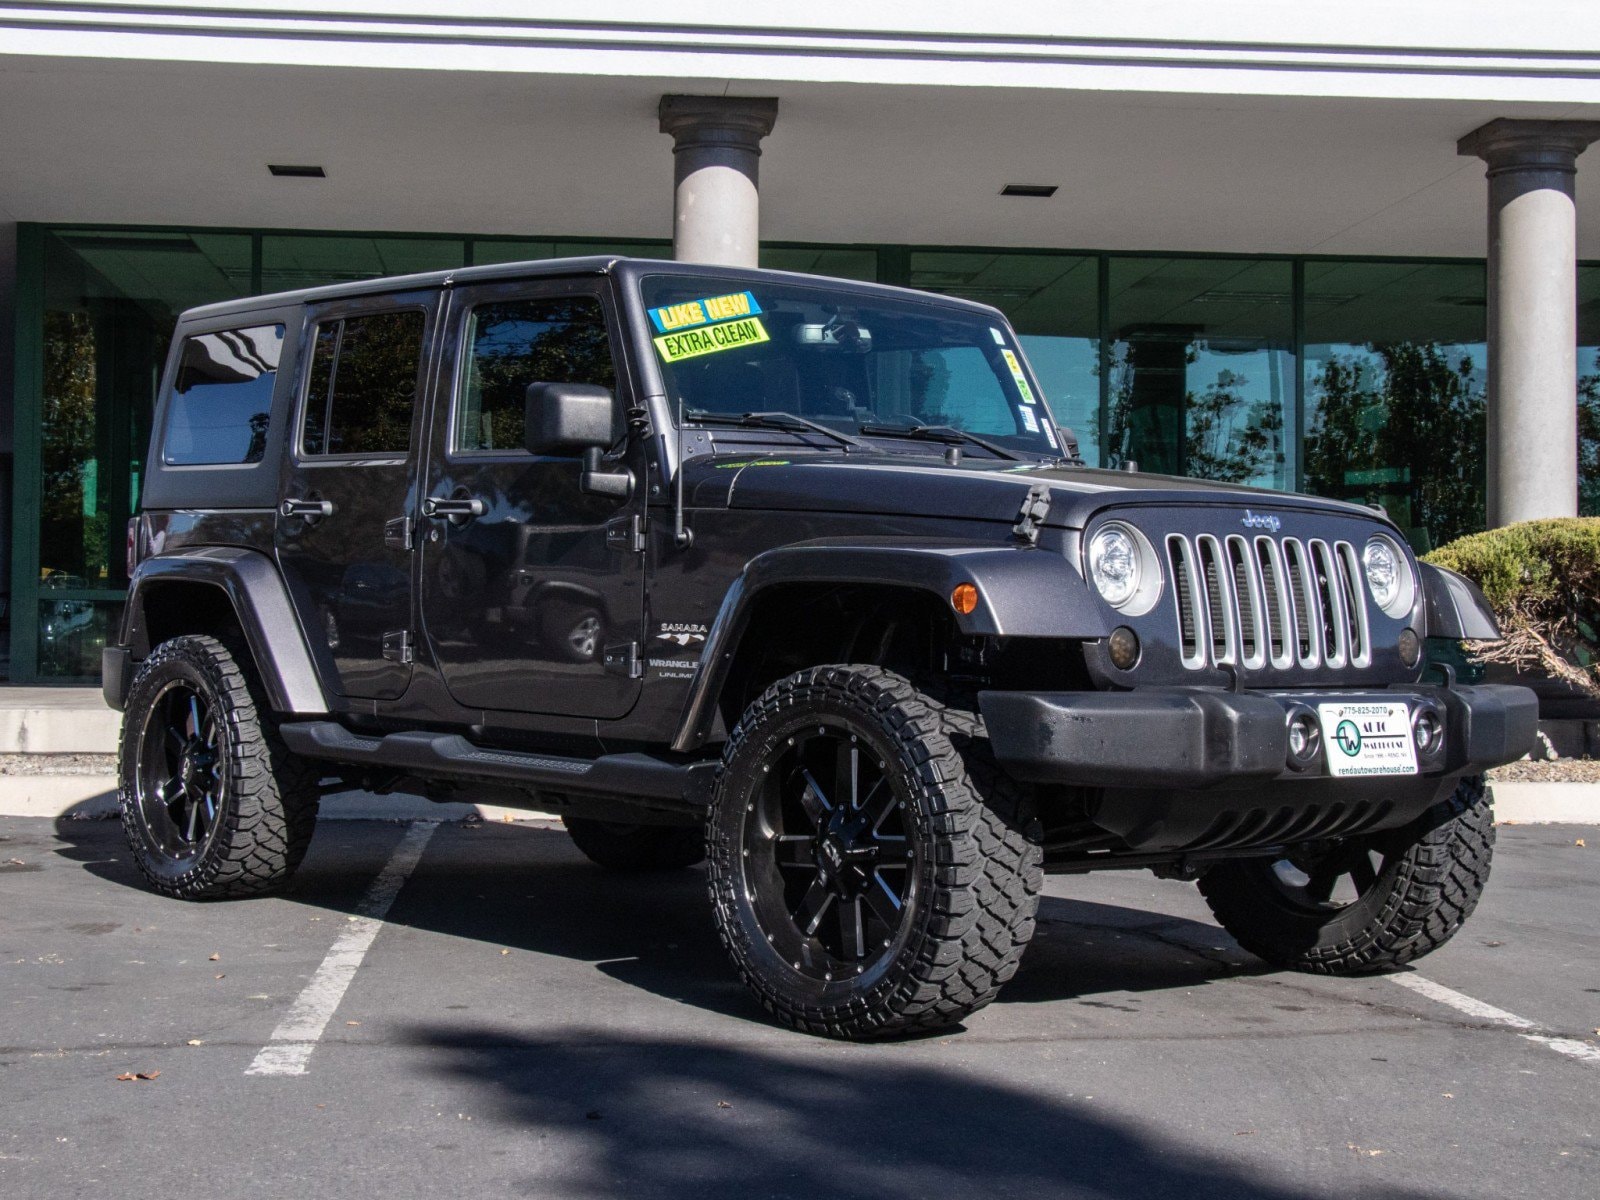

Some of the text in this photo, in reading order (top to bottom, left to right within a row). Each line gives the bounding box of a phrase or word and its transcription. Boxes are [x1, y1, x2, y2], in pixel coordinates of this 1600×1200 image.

[657, 293, 751, 330] LIKE NEW
[664, 320, 759, 357] EXTRA CLEAN
[1242, 509, 1281, 533] Jeep
[661, 623, 707, 632] SAHARA
[649, 659, 699, 668] WRANGLE
